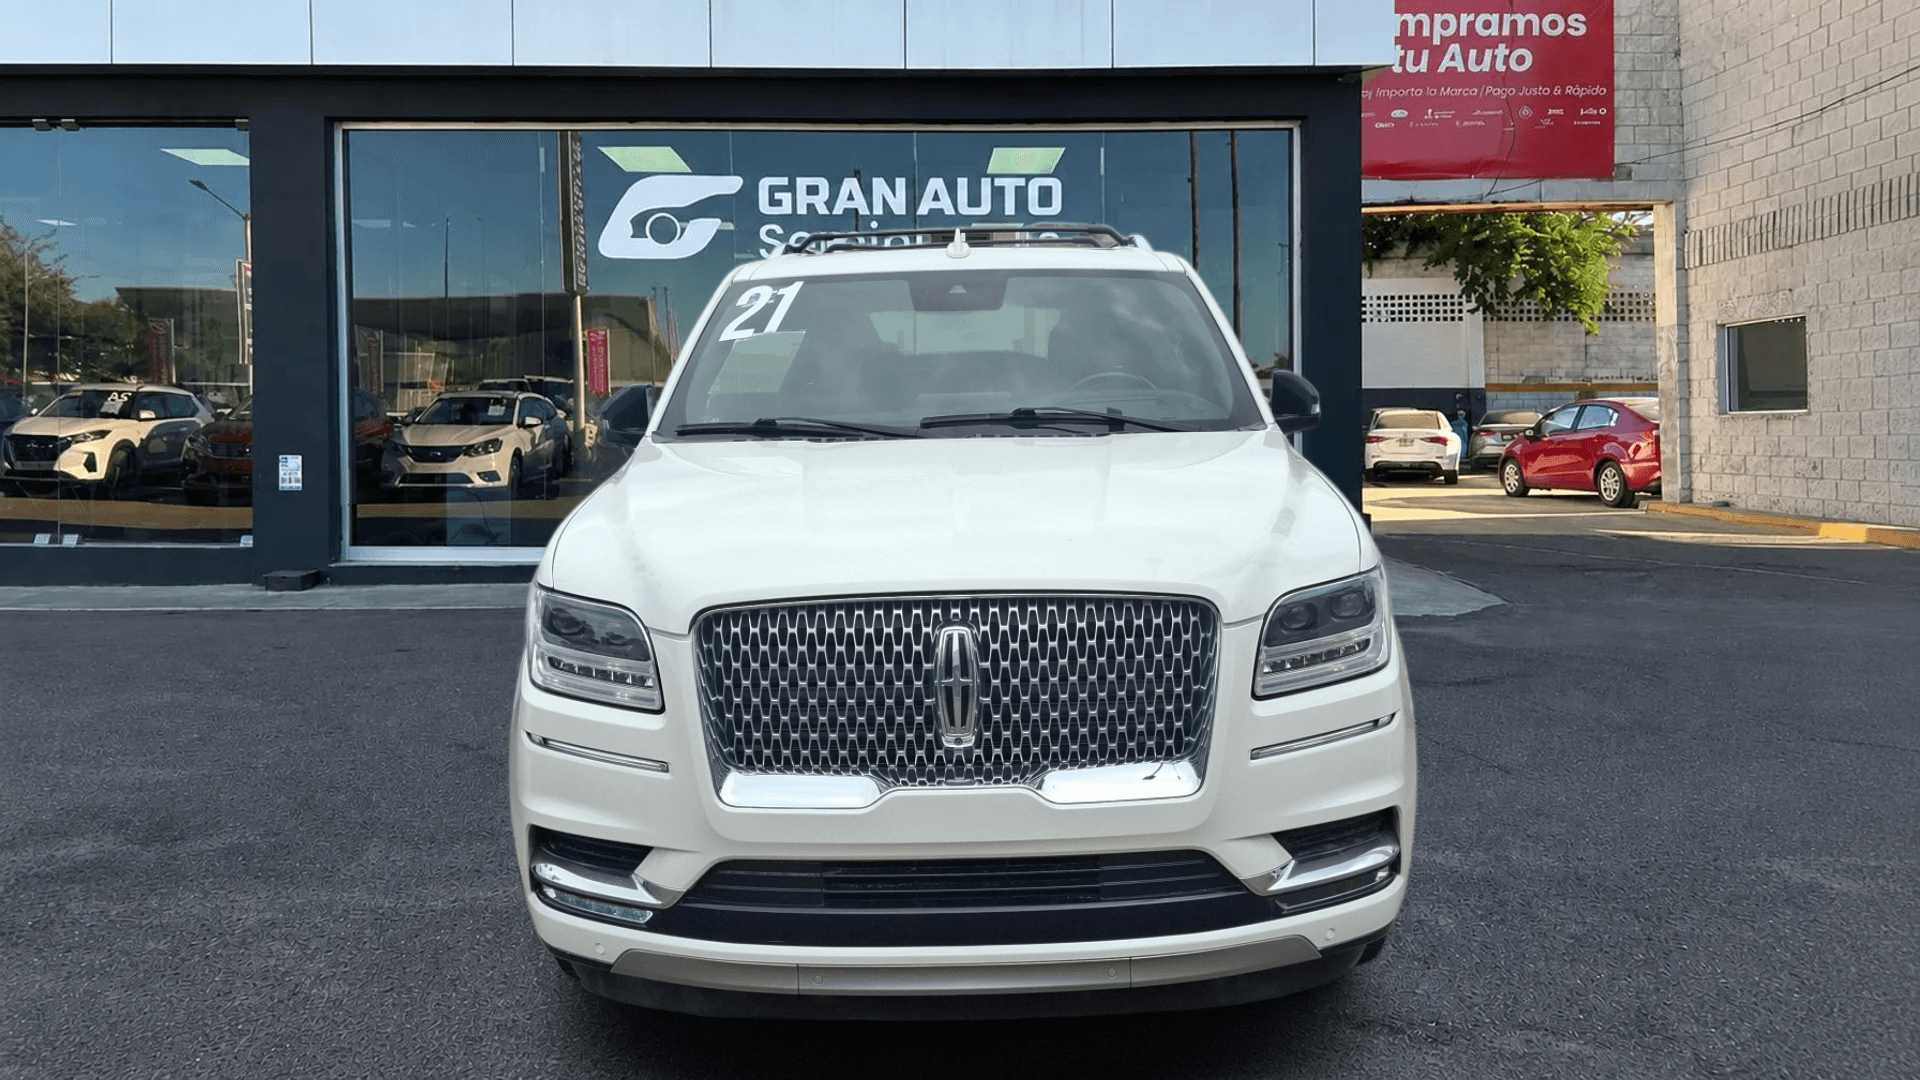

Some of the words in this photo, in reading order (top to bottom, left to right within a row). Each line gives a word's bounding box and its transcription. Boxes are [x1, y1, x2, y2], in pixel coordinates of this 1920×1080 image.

[1394, 12, 1587, 46] mpramos
[1392, 45, 1430, 74] tu
[1436, 43, 1534, 74] Auto
[1375, 86, 1424, 100] Importa
[1425, 86, 1438, 97] la
[1439, 86, 1479, 97] Marca
[1518, 85, 1551, 97] Justo
[1552, 85, 1562, 96] &
[1564, 83, 1608, 98] Rápido
[758, 176, 907, 216] GRAN
[916, 176, 1064, 216] AUTO
[718, 280, 805, 343] 21
